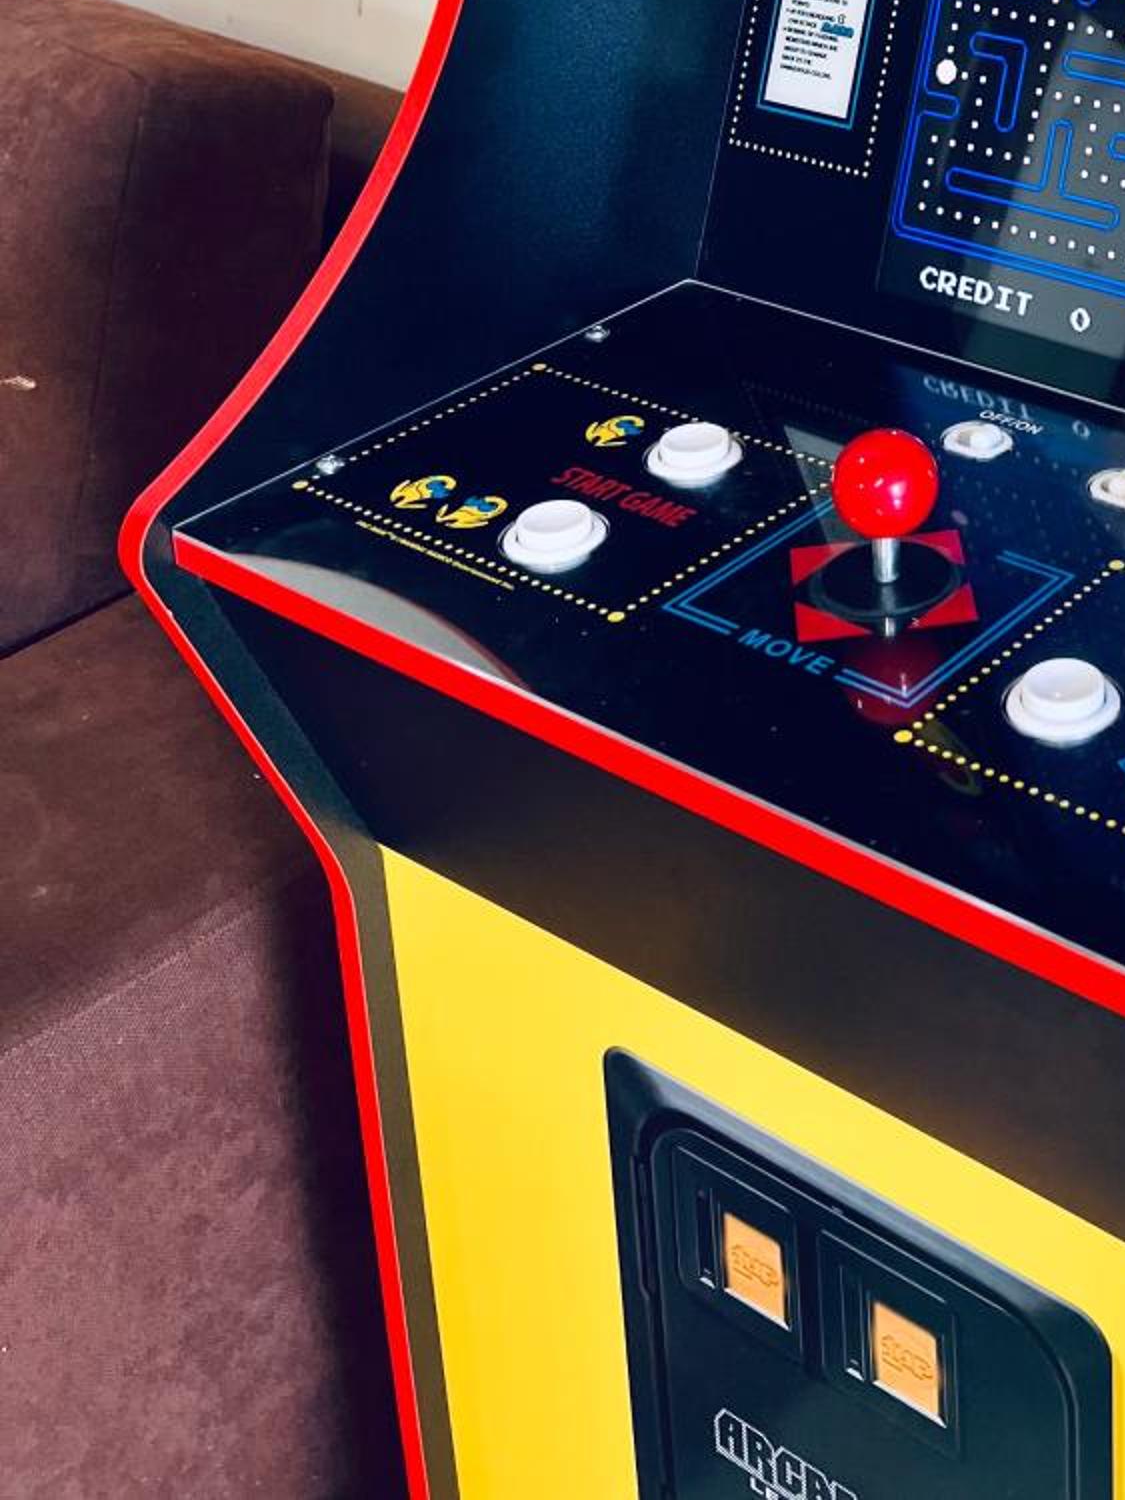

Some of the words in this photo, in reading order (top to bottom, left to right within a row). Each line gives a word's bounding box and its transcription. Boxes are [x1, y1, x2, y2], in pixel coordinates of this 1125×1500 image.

[918, 265, 1033, 317] CREDIT
[979, 409, 1044, 435] OFF/ON
[552, 467, 632, 501] START
[619, 491, 698, 528] GAME
[738, 628, 837, 678] MOVE
[714, 1407, 858, 1500] ARCA
